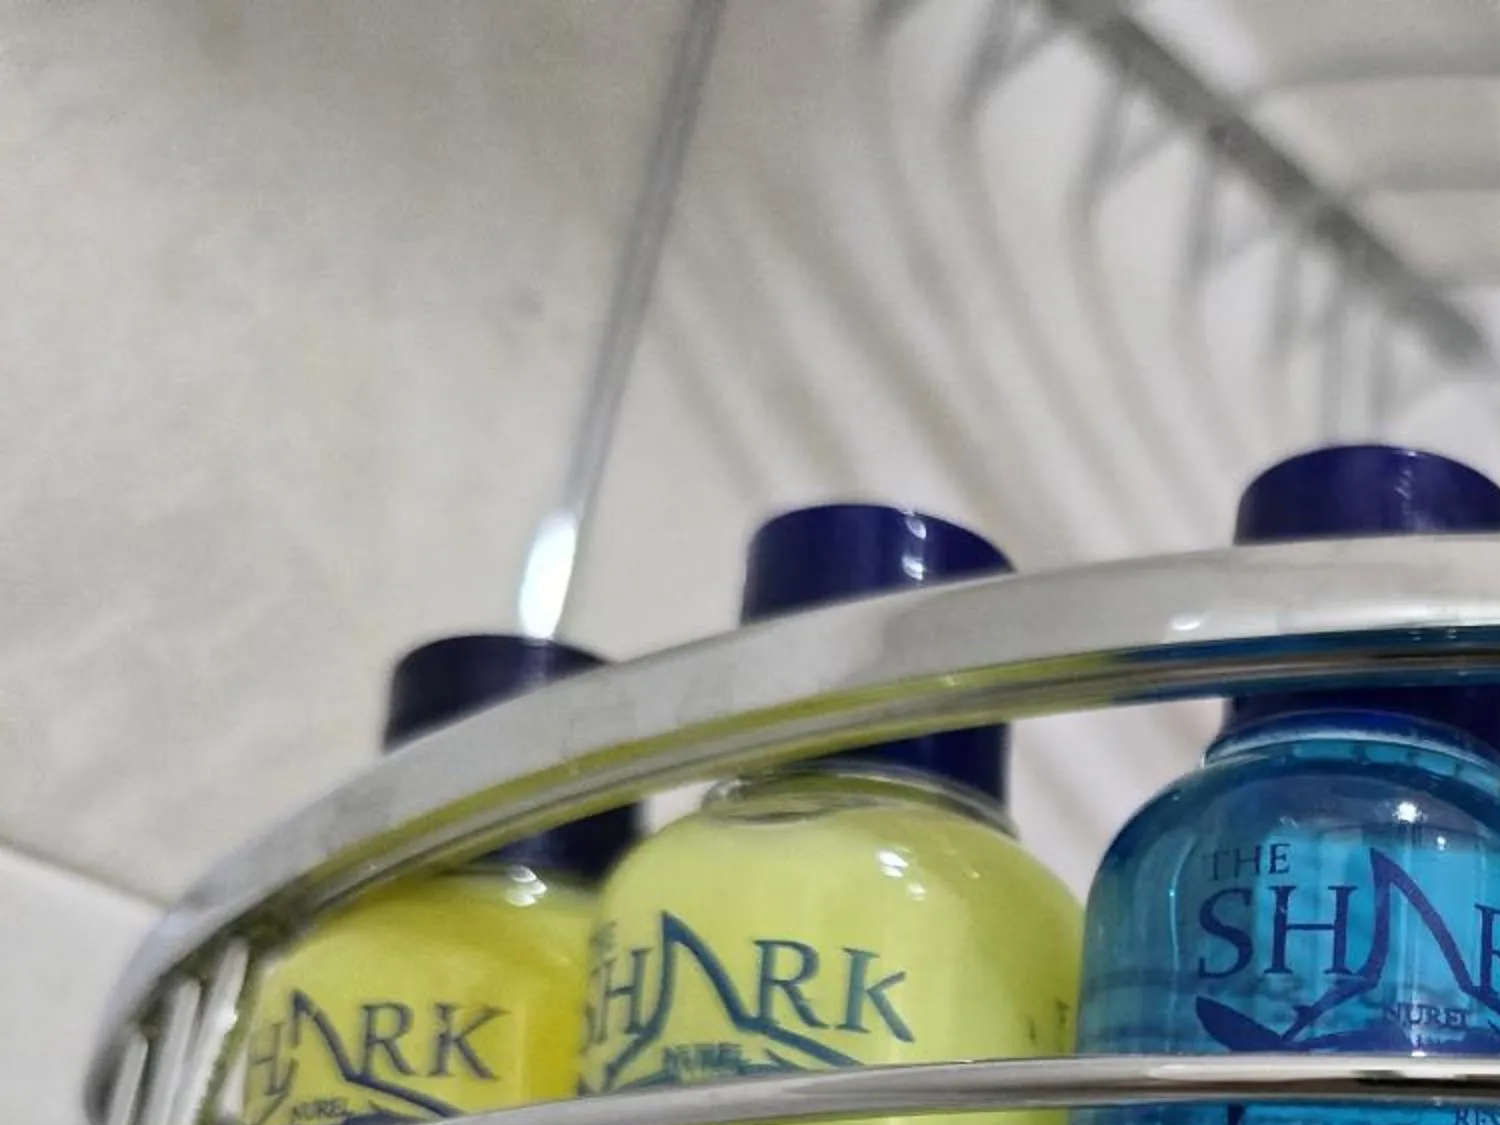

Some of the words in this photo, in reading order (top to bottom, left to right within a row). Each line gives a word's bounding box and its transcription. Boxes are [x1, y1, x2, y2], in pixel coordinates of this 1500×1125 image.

[1208, 842, 1291, 882] THE
[584, 910, 915, 1052] HARK
[250, 987, 513, 1098] HARK
